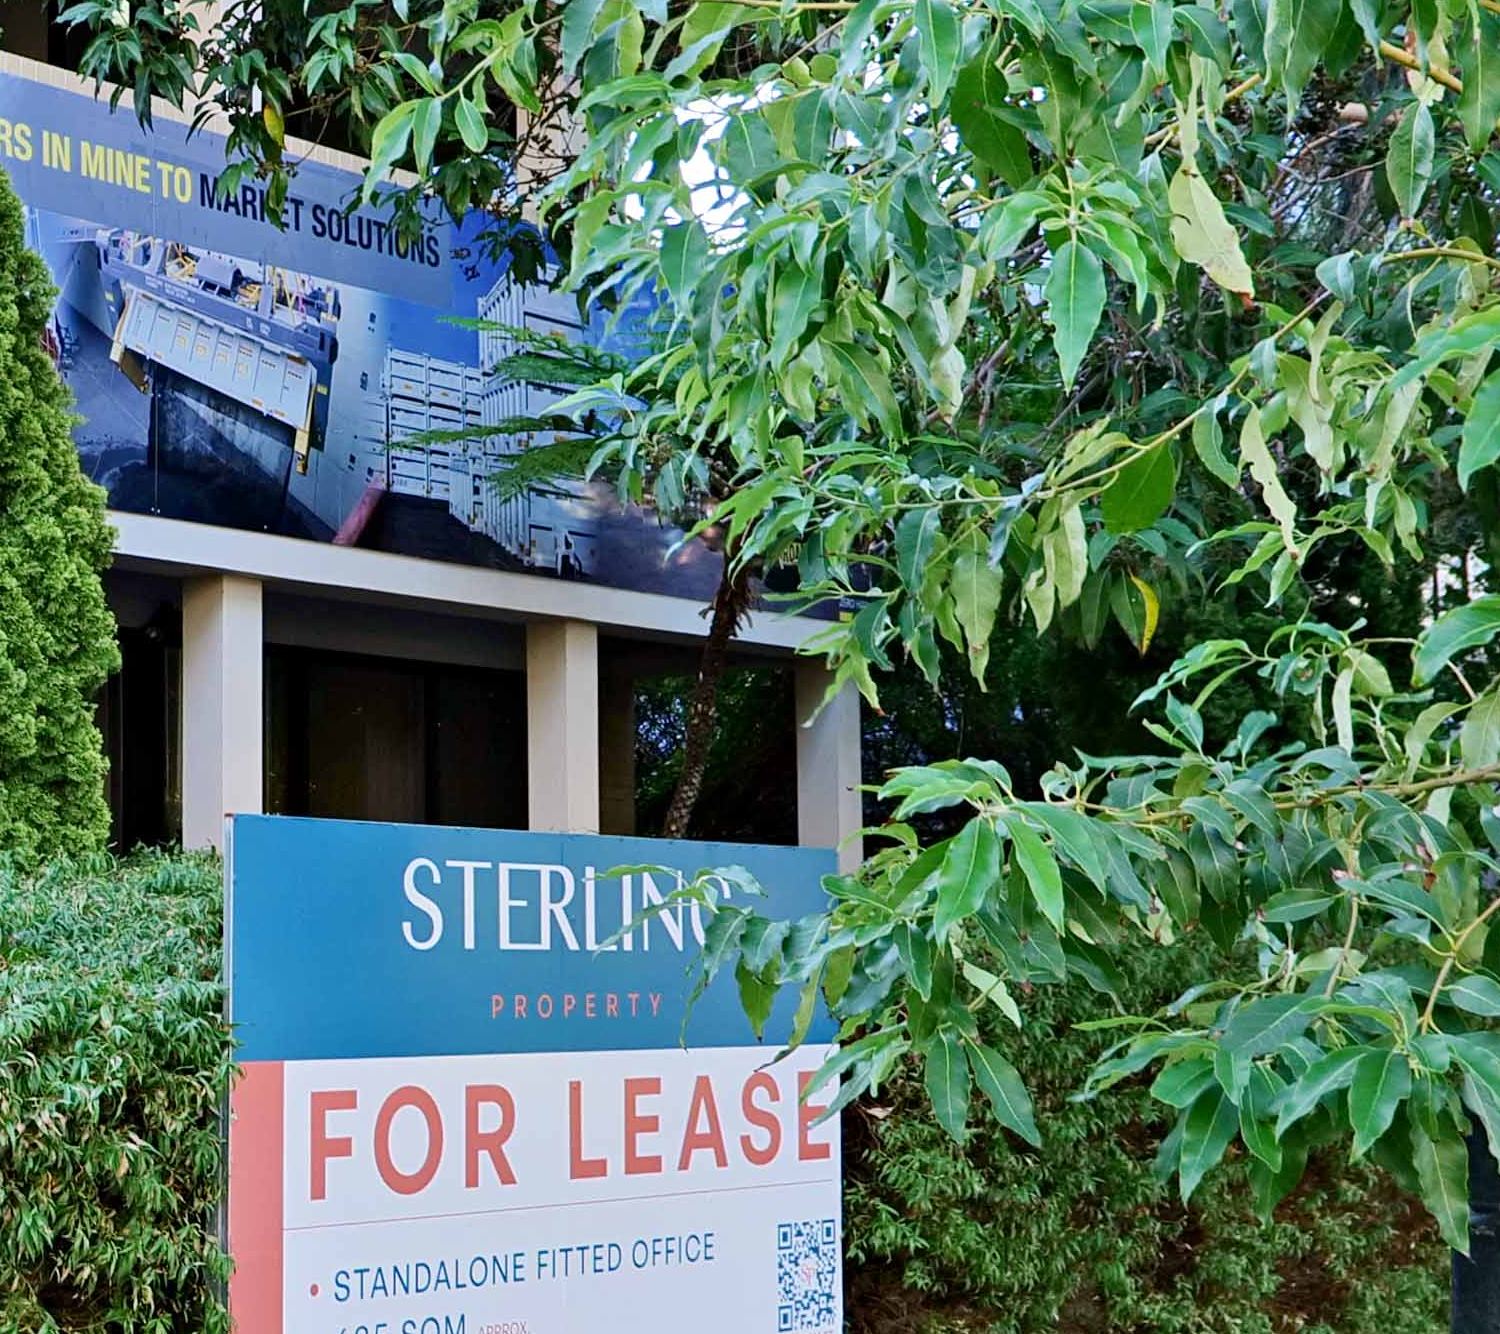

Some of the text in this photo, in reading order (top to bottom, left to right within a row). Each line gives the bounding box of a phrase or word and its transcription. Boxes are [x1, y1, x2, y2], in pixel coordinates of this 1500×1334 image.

[42, 130, 71, 172] IN
[80, 140, 151, 194] MINE
[157, 161, 193, 204] TO
[200, 172, 304, 232] MART
[312, 203, 440, 268] SOLUTIONS
[491, 992, 663, 1019] PROPERTY
[310, 1071, 831, 1200] FOR LEASE
[333, 1232, 715, 1303] STANDALONE FITTED OFFICE
